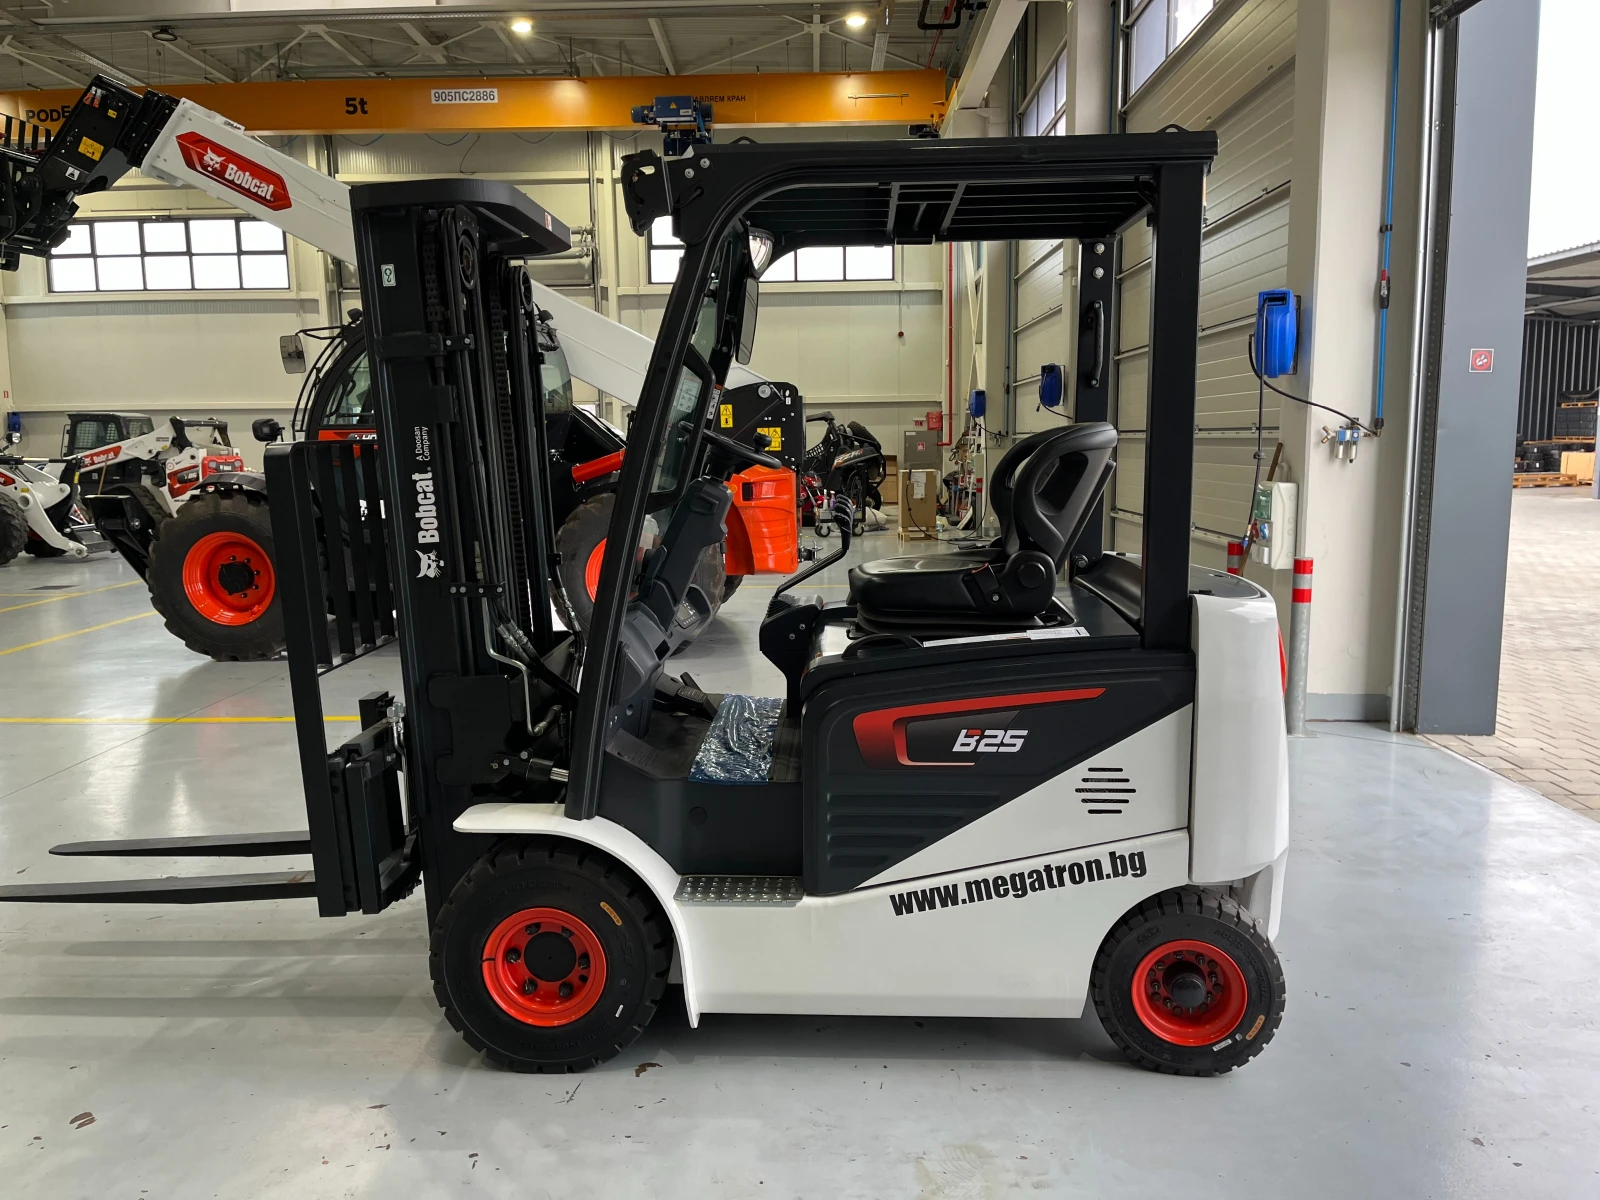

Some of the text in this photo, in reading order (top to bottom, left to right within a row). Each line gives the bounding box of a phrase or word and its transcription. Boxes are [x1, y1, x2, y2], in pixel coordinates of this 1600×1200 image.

[345, 97, 368, 115] 5t
[433, 90, 496, 102] 905ПС2886
[692, 95, 725, 103] АВЛЯЕМ
[224, 163, 275, 201] Bobcat
[414, 426, 423, 454] Doosan
[421, 426, 431, 461] Company
[411, 472, 440, 544] Bobcat
[952, 729, 1029, 753] B25
[889, 850, 1148, 917] www.megatron.bg
